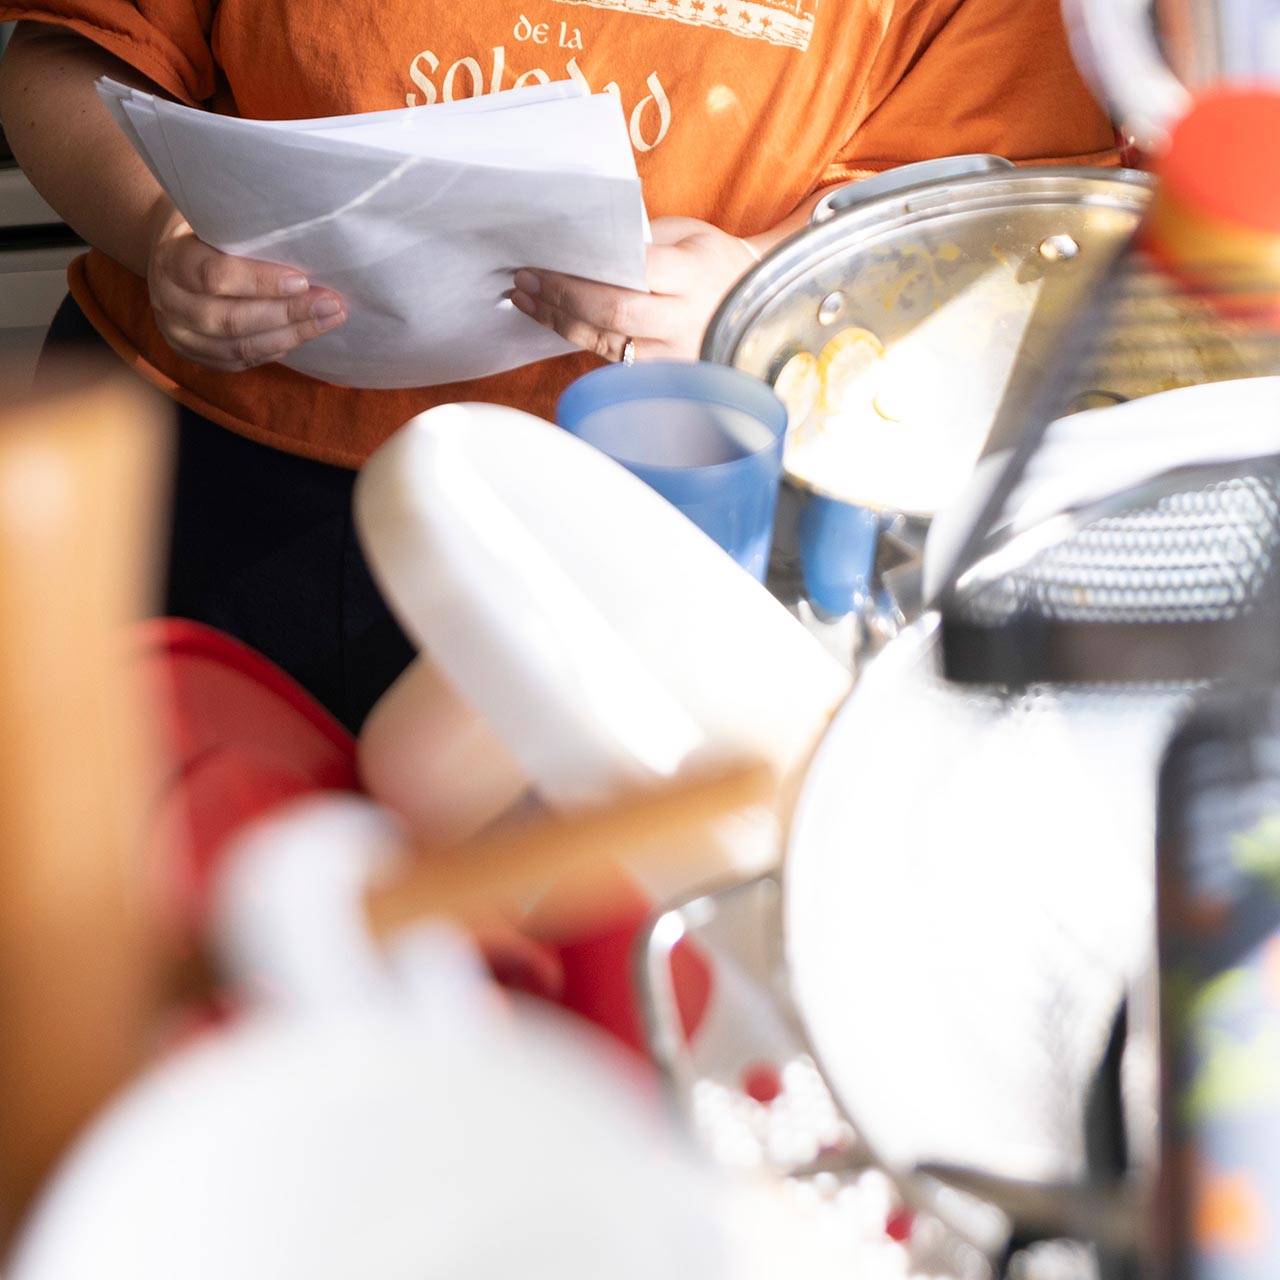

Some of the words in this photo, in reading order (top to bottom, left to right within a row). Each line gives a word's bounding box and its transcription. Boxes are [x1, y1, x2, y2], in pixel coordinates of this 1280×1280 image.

[513, 14, 550, 45] de
[559, 21, 584, 50] la
[406, 45, 671, 152] sold
